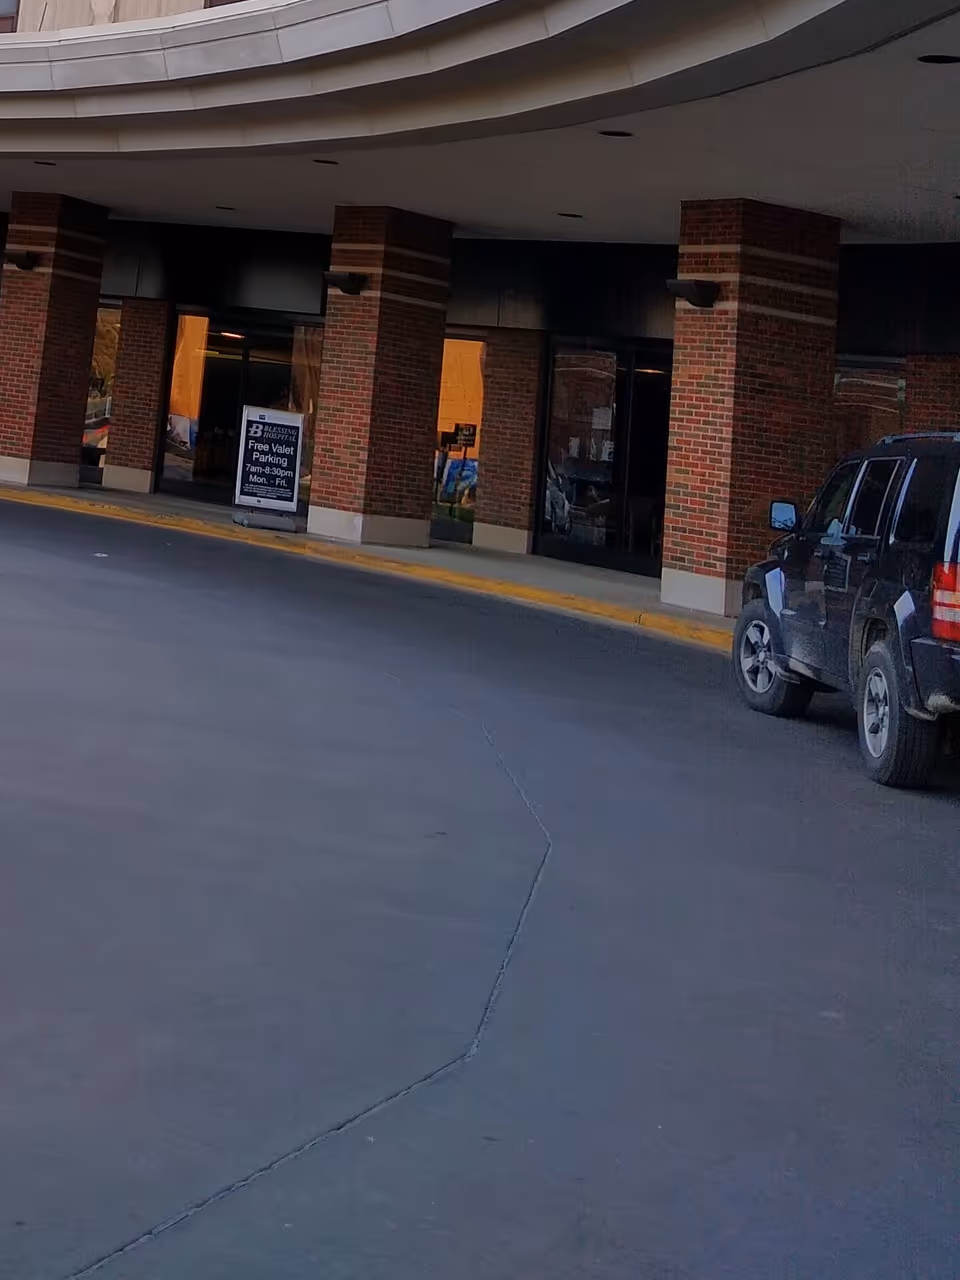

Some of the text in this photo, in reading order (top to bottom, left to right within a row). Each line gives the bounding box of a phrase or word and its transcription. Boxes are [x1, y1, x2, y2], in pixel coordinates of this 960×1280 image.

[262, 431, 296, 442] HOSPITAL
[263, 425, 297, 435] BLESSING
[248, 440, 294, 455] Free Valet
[252, 451, 288, 467] Parking
[245, 463, 293, 477] 7am-8:30pm
[248, 474, 268, 484] Mon.
[275, 478, 287, 487] Fri.
